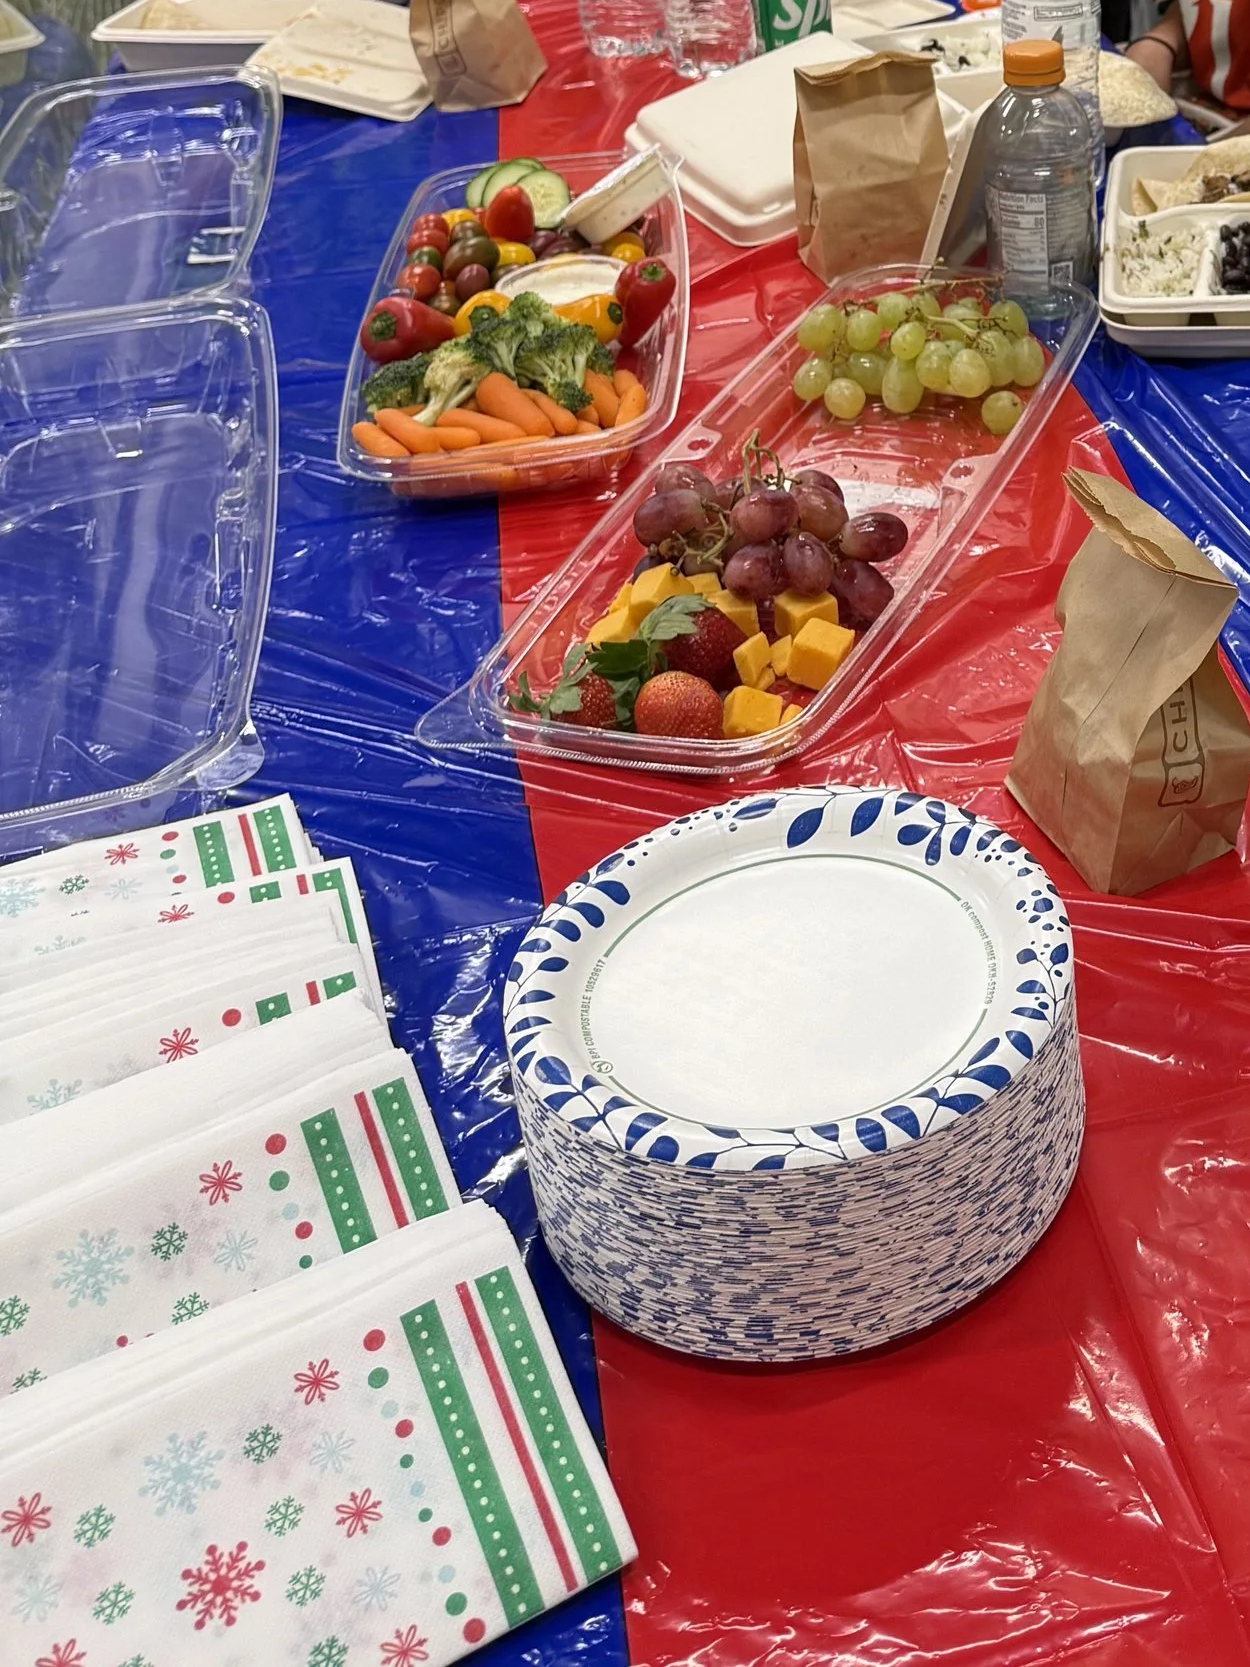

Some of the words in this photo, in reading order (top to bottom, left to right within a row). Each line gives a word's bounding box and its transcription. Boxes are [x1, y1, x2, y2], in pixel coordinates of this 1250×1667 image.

[968, 911, 989, 940] compost
[984, 940, 996, 962] HOME
[580, 995, 595, 1046] COMPOSTABLE
